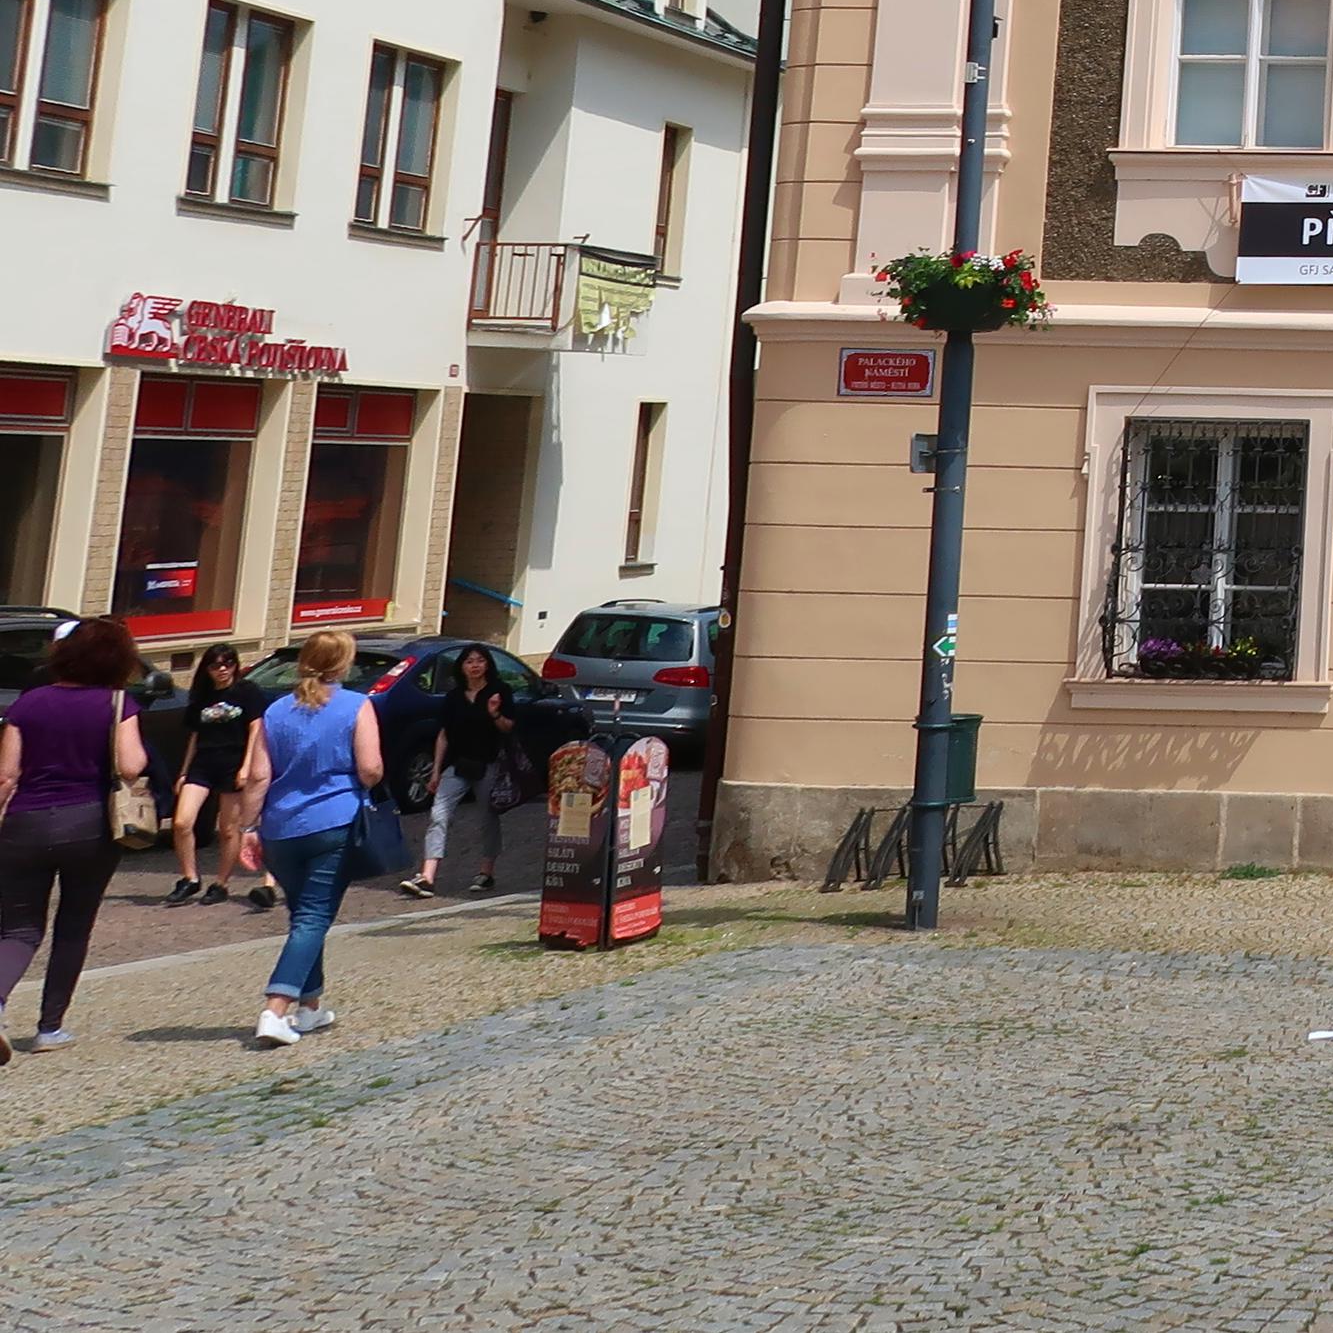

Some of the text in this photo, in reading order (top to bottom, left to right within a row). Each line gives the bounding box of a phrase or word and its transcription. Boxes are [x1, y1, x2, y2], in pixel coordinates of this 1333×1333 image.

[1299, 264, 1320, 276] GFJ
[186, 299, 276, 335] GENERALI
[857, 356, 917, 367] PALACKÉHO
[864, 366, 909, 378] NÁMĚSTÍ
